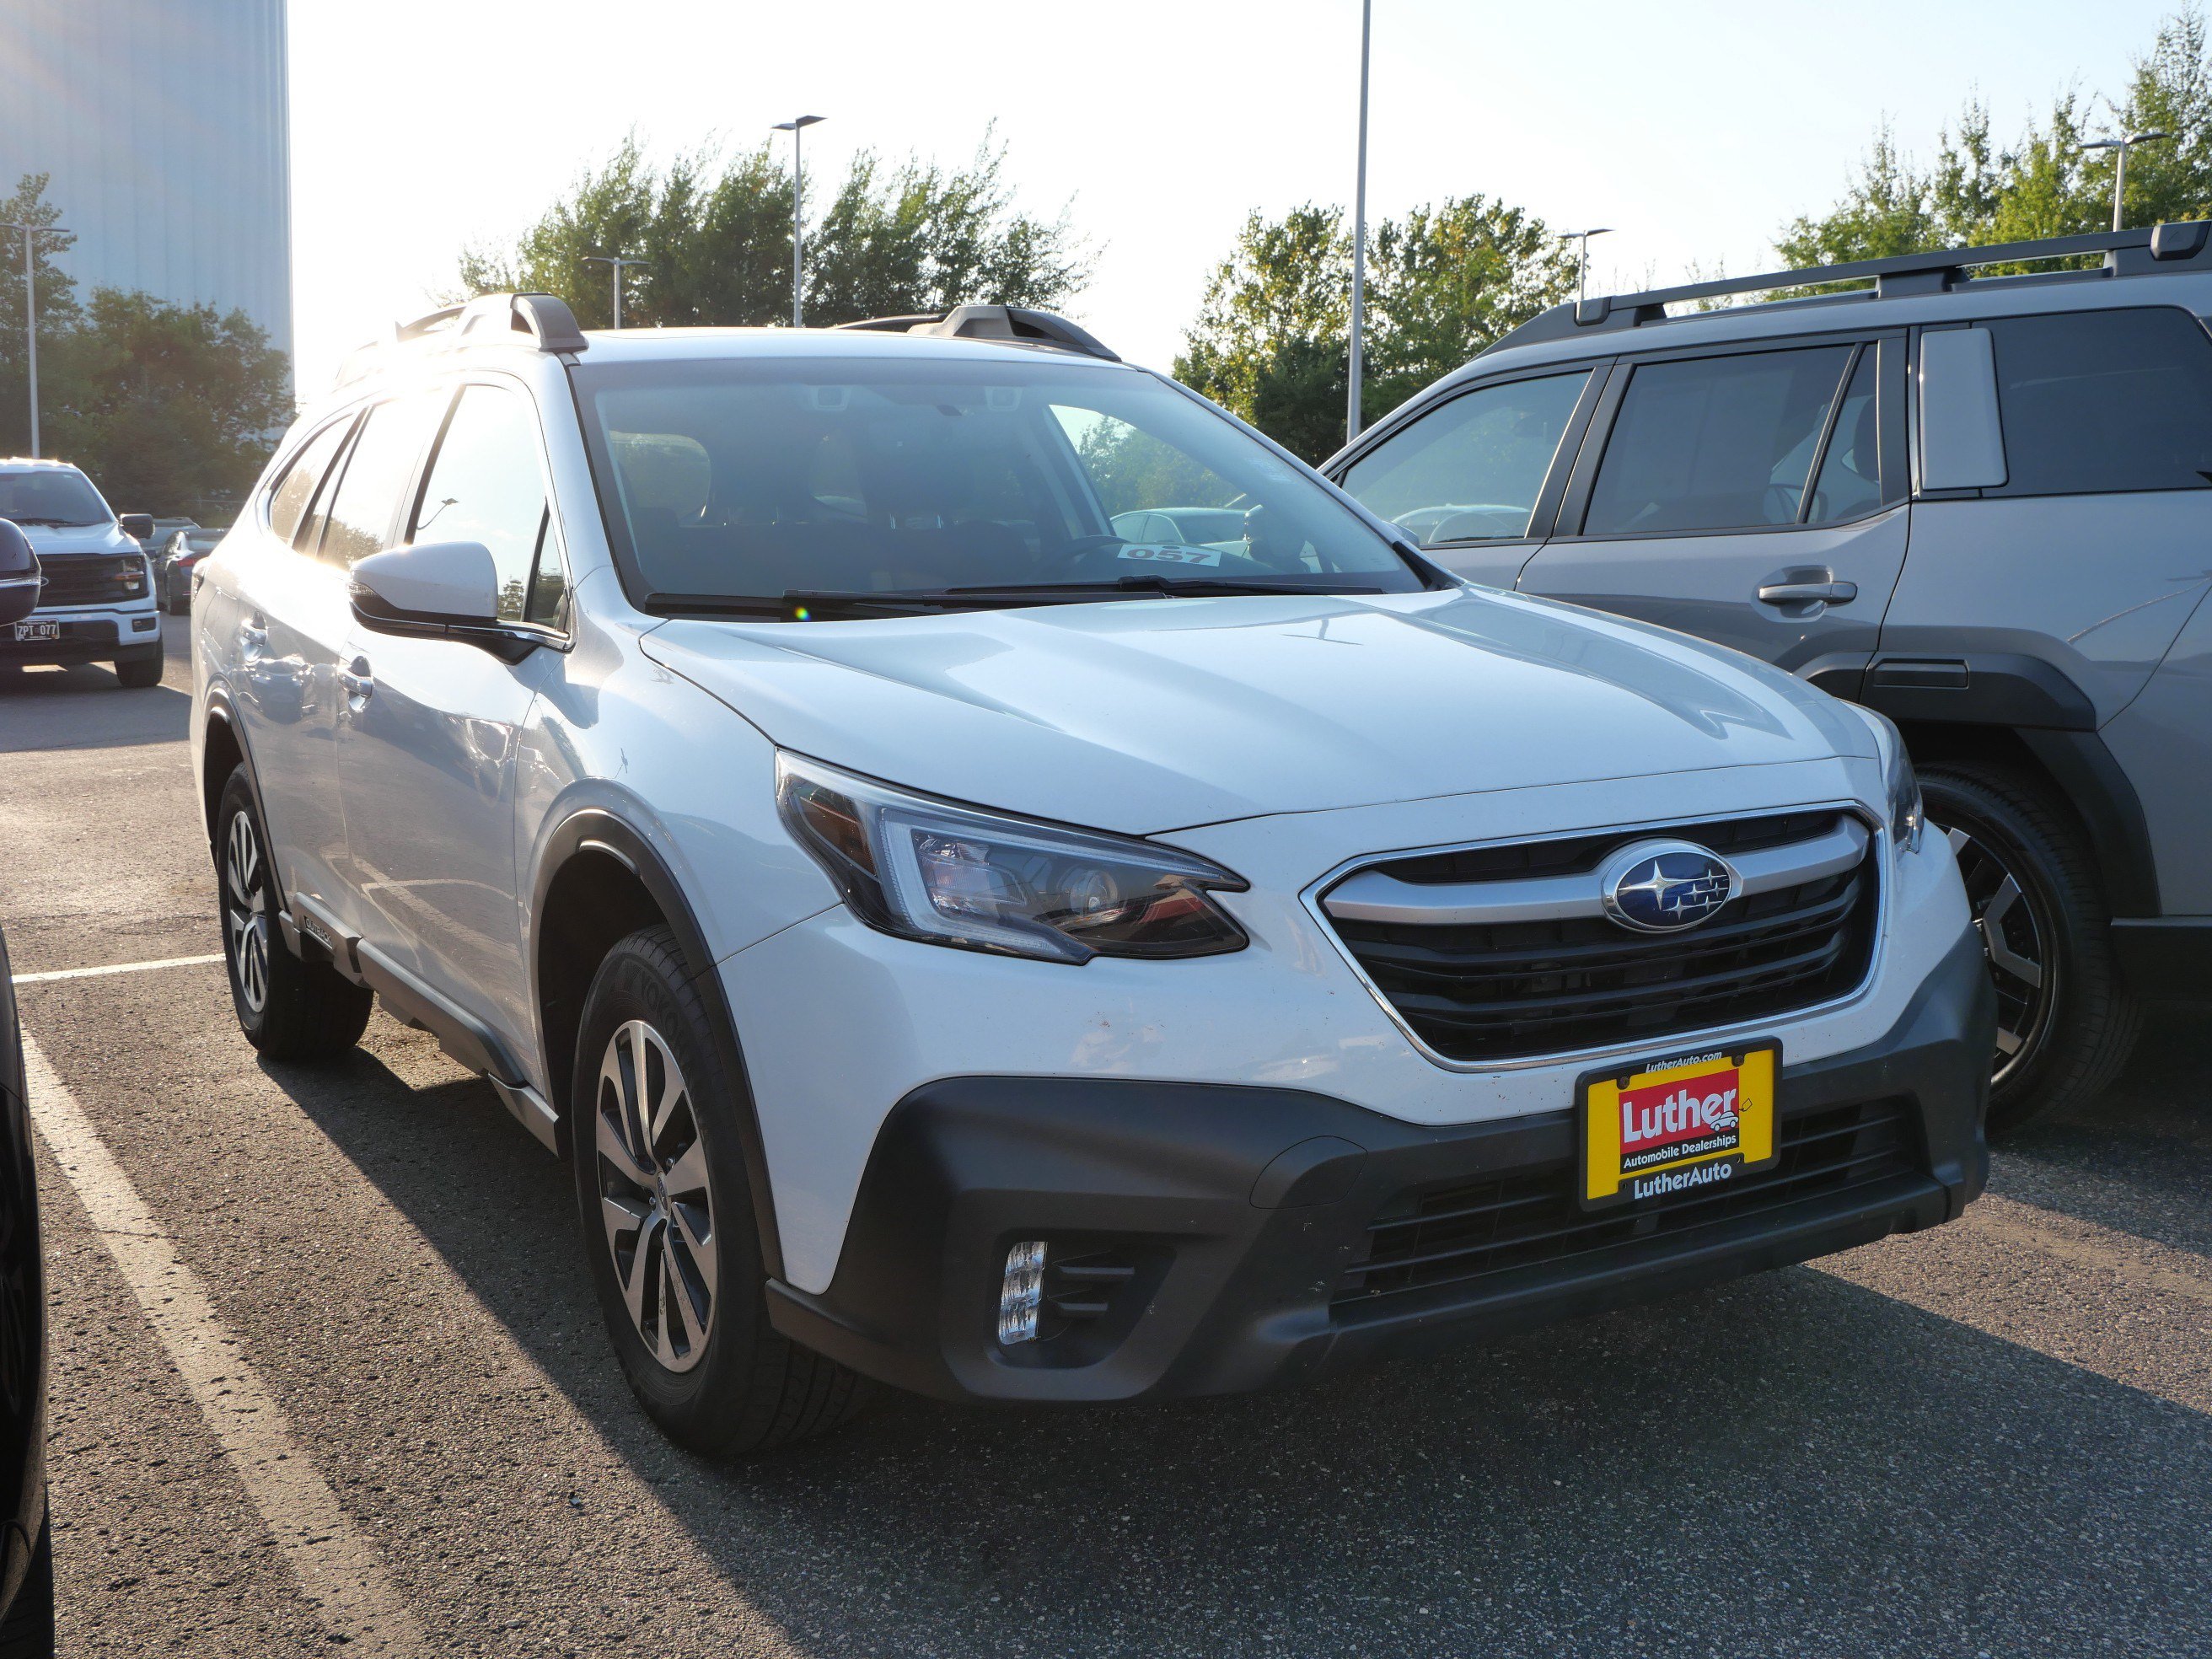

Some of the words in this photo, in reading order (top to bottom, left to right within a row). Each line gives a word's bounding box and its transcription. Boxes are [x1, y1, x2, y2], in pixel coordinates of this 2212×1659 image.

[1126, 548, 1211, 563] 057
[40, 625, 56, 635] 077
[305, 918, 332, 945] OUTBACK
[1646, 1051, 1722, 1074] LutherAuto.com
[1623, 1088, 1737, 1143] Luther
[1623, 1145, 1679, 1169] Automobile
[1682, 1134, 1737, 1155] Dealerships
[1634, 1163, 1732, 1200] LutherAuto
